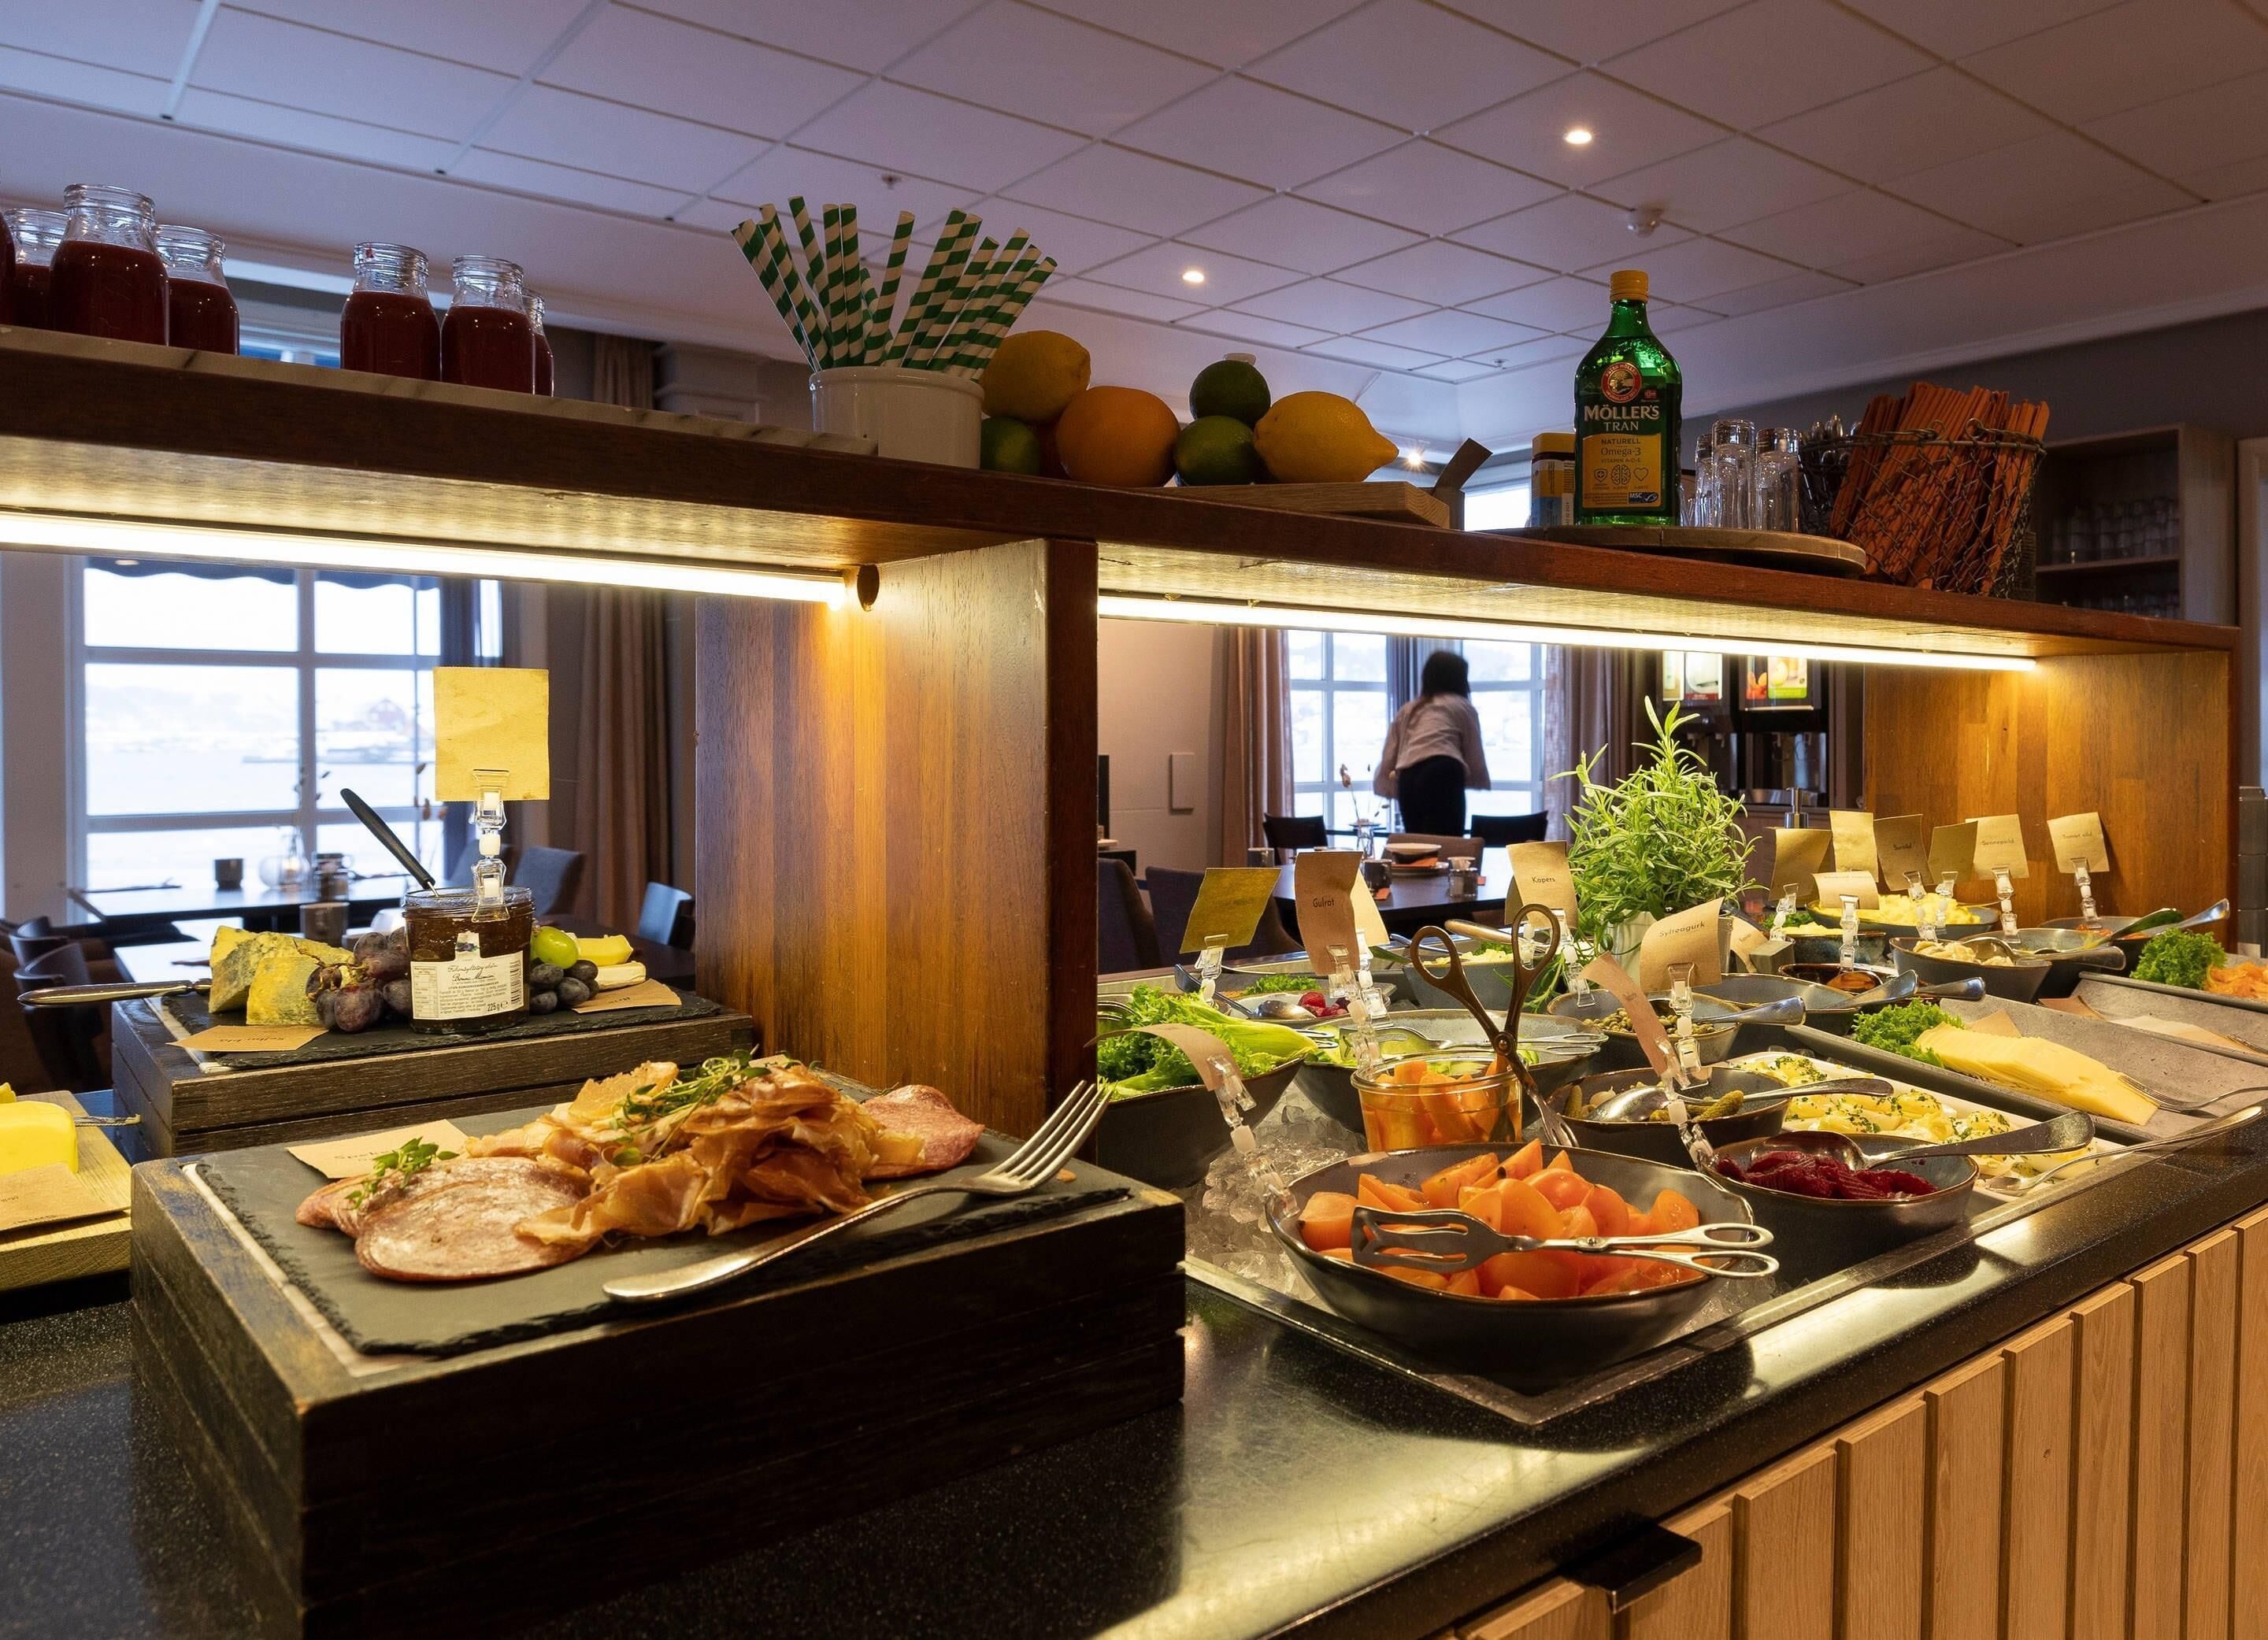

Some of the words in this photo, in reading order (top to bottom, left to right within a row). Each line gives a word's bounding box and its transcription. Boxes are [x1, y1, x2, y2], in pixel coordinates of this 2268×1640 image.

[1584, 404, 1660, 421] MÖLLER'S
[1603, 421, 1639, 431] TRAN
[1601, 446, 1641, 457] Omega-3
[1313, 897, 1335, 908] Gulrot
[1657, 920, 1706, 938] Sylteagurk
